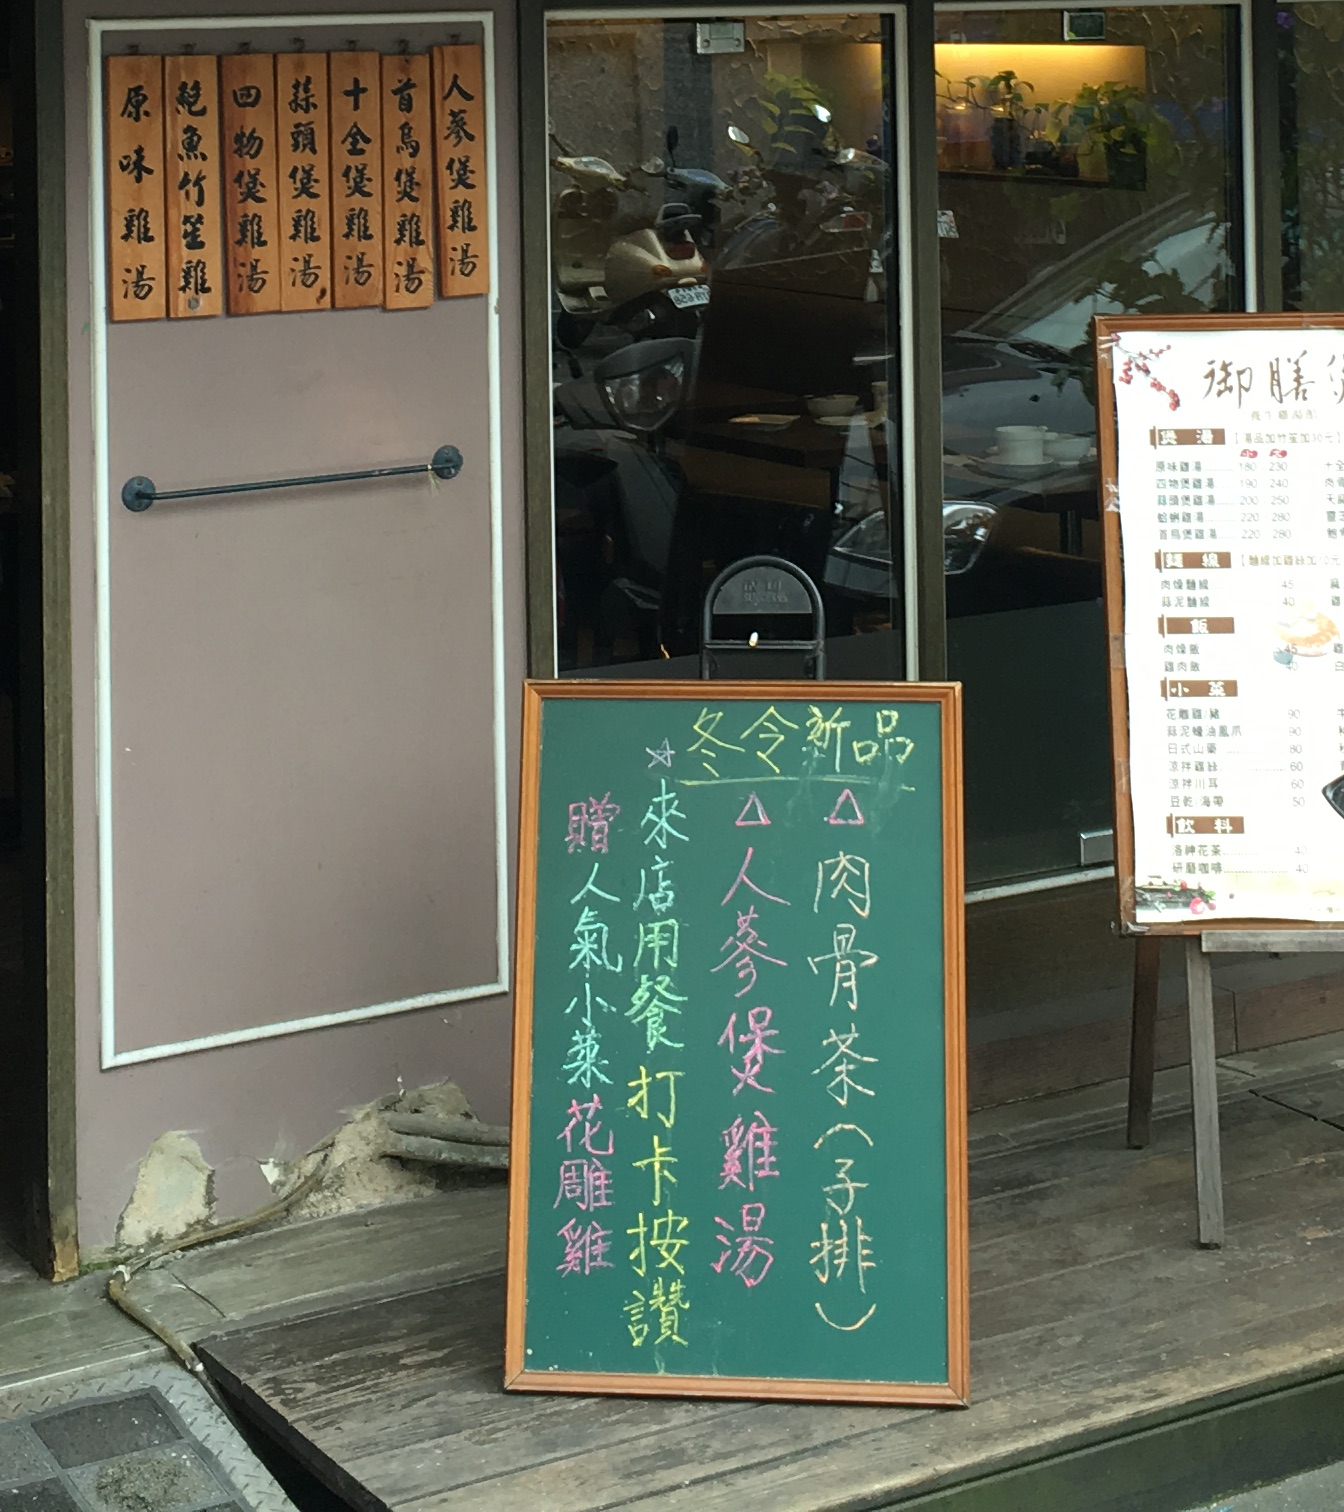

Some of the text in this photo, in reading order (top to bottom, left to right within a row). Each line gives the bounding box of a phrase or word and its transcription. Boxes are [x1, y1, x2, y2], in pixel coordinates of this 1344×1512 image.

[119, 84, 156, 300] 原味雞湯
[174, 79, 213, 296] 鮑魚竹笙雞
[232, 84, 269, 294] 四物煲雞湯
[287, 74, 323, 290] 蒜頭煲雞湯
[340, 76, 375, 287] 十全煲雞湯
[686, 704, 915, 778] 冬令新品
[1176, 818, 1233, 834] 飲料
[553, 791, 623, 1278] 贈人氣小菜花雕雞
[622, 778, 691, 1348] 來店用餐打卡按讚
